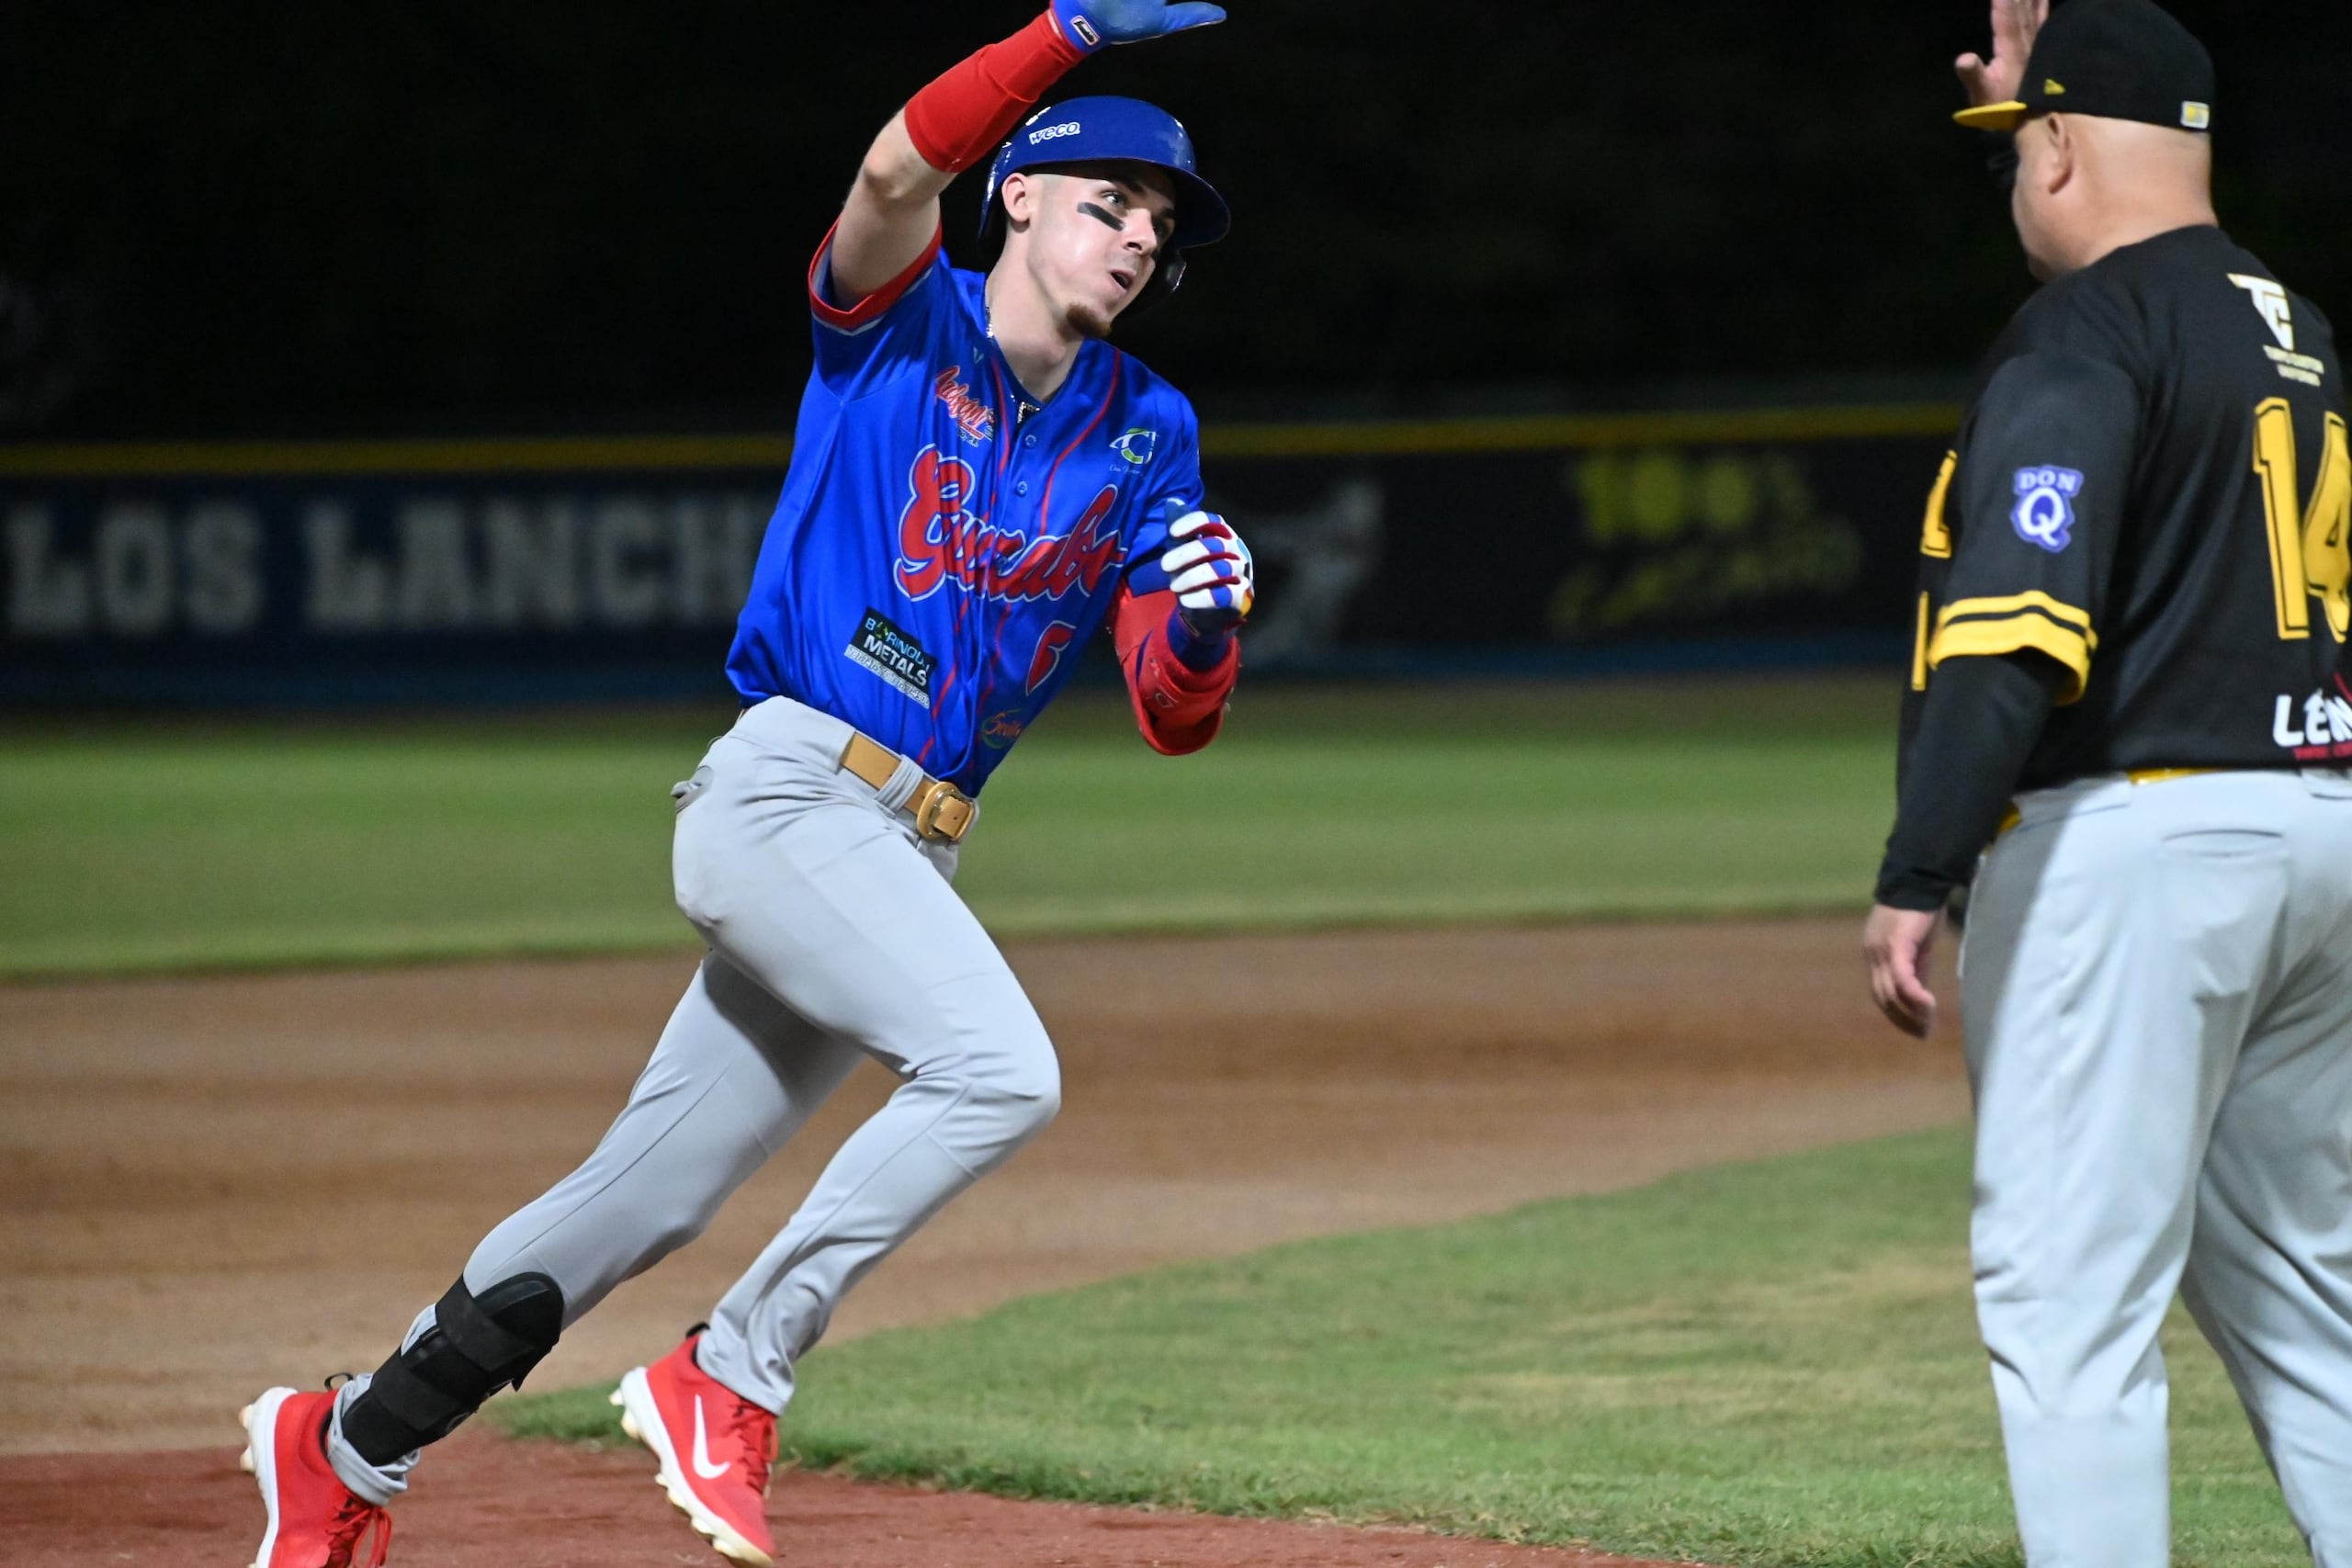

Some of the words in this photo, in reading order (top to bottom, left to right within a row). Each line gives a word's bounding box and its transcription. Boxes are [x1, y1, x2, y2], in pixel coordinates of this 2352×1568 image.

[2018, 469, 2076, 492] DON
[2018, 485, 2065, 547] Q
[2253, 397, 2351, 643] 14
[6, 502, 261, 634] LOS
[863, 634, 927, 687] METALS
